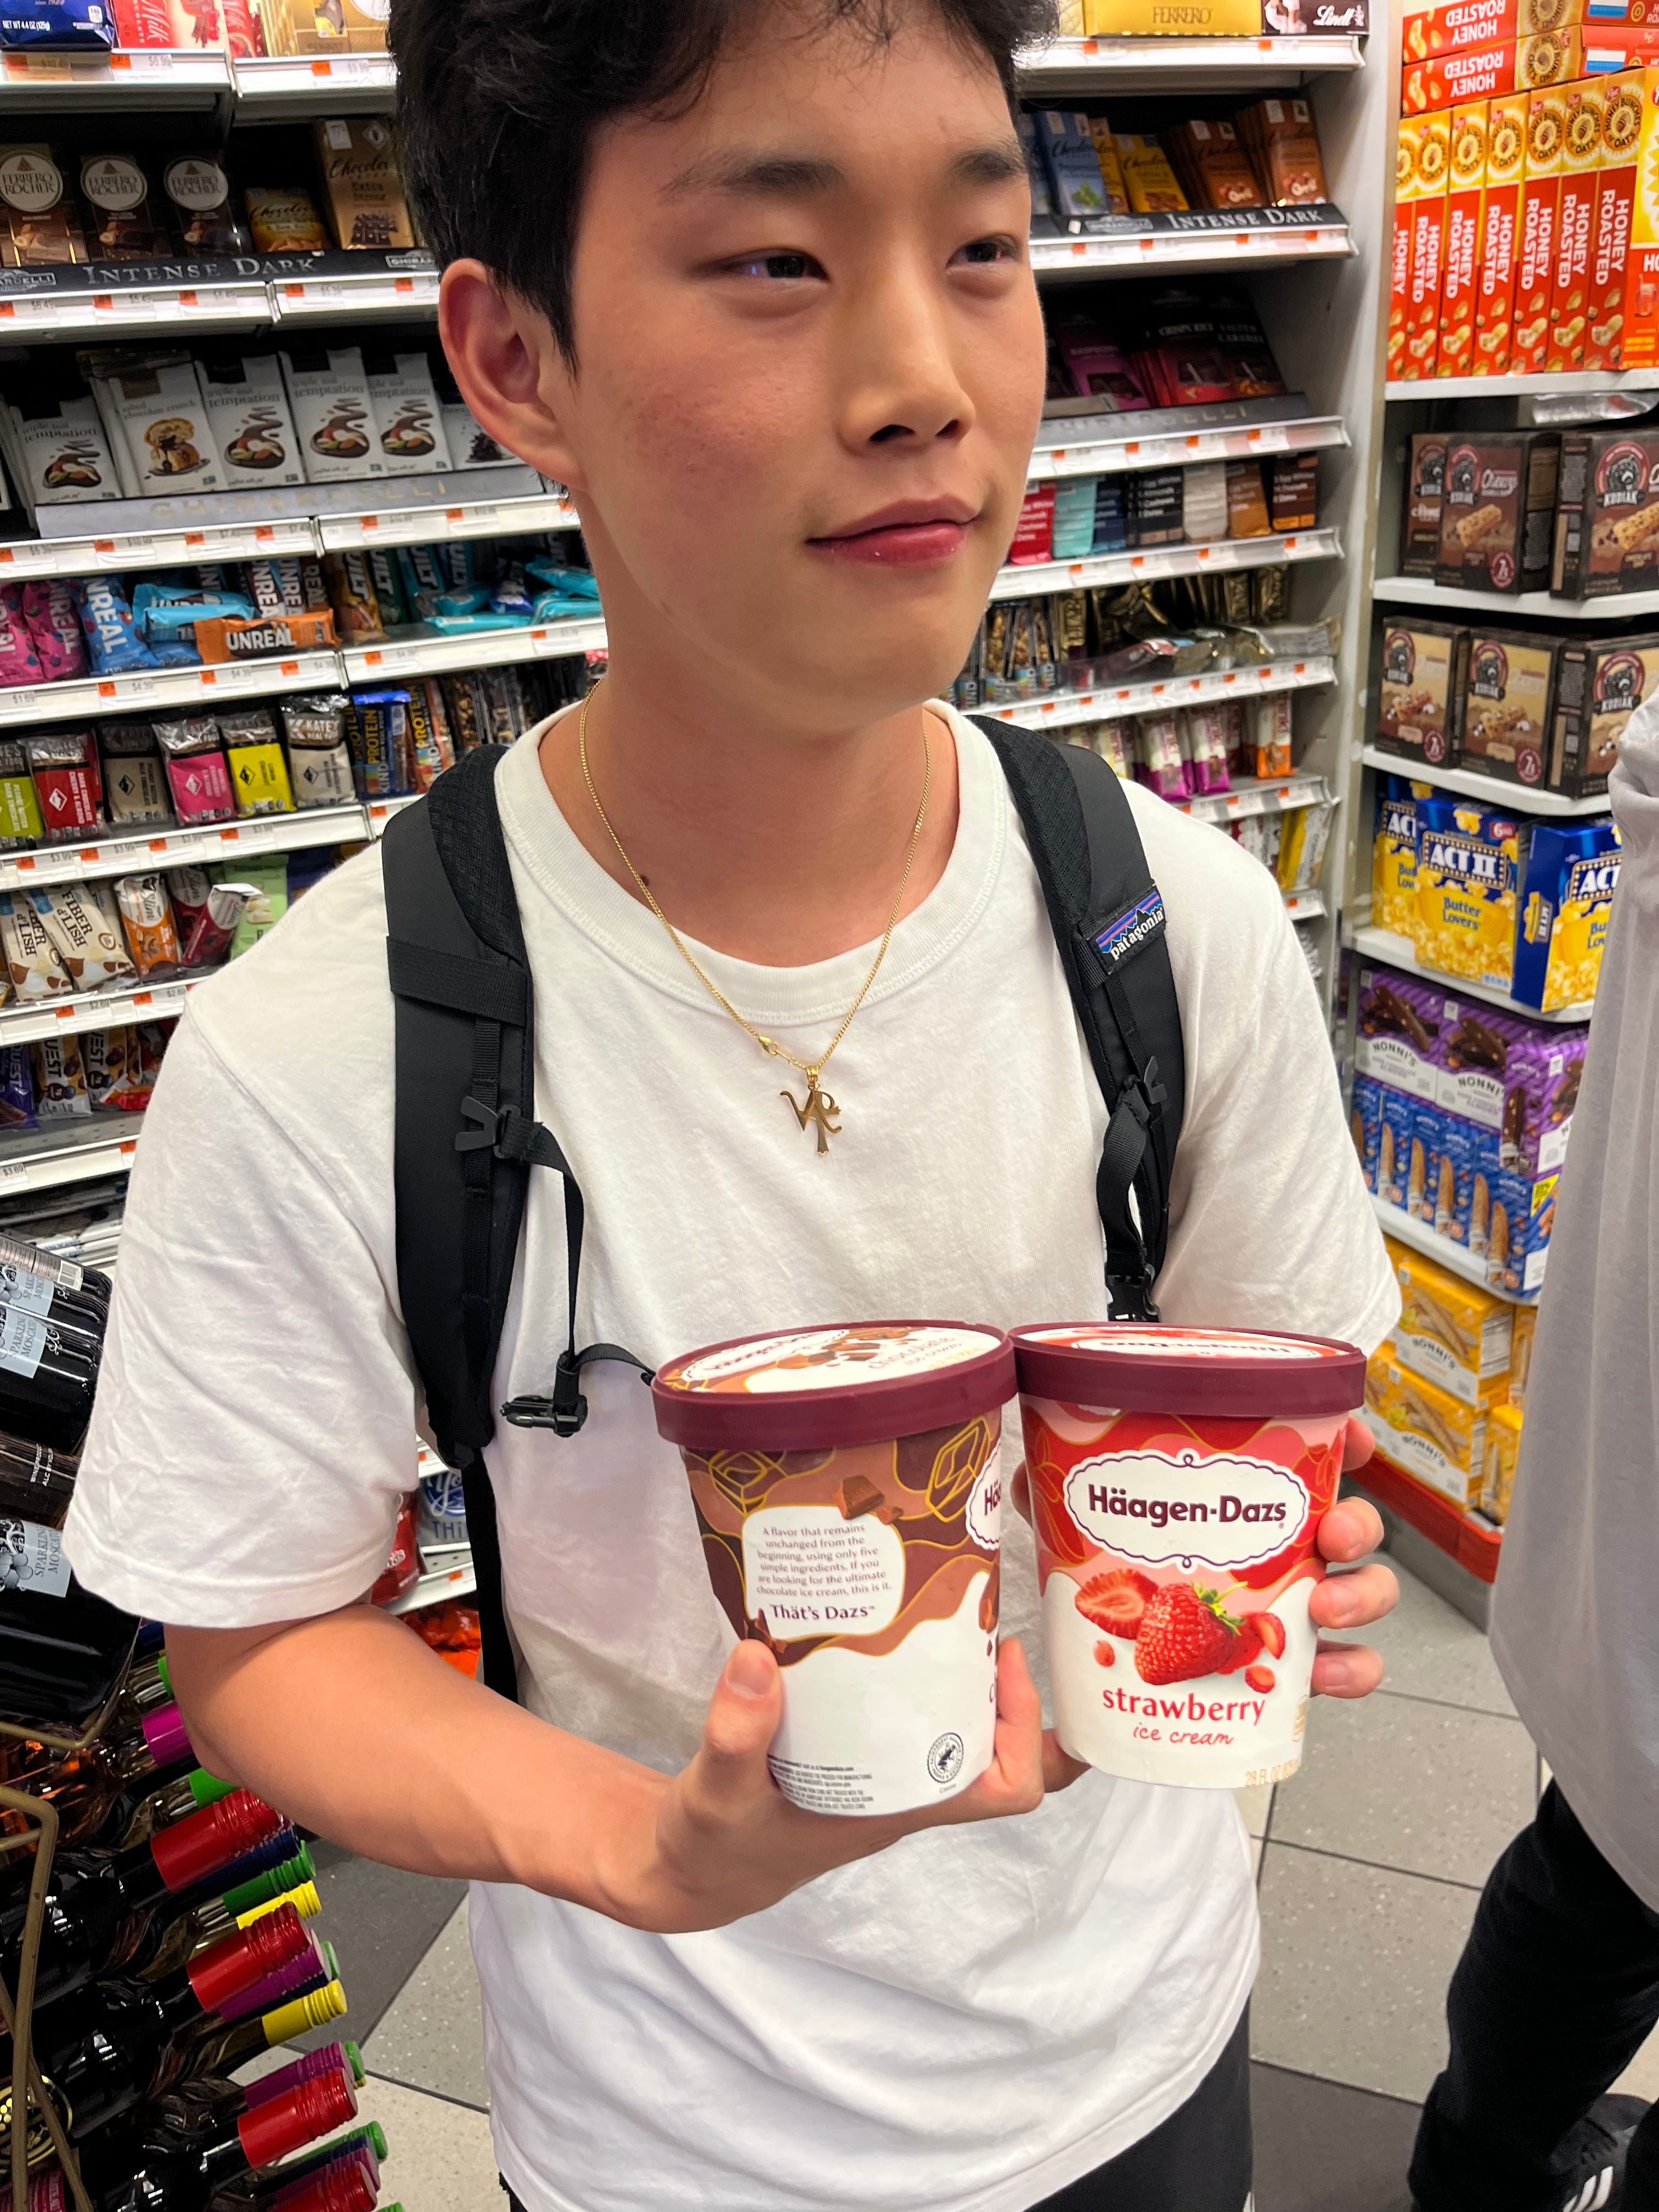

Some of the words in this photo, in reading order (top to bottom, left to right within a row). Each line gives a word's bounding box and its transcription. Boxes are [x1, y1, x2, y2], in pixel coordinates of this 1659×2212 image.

[1153, 5, 1211, 24] FERRERO
[1312, 5, 1356, 27] Lindt
[1451, 19, 1497, 46] HONEY
[1444, 50, 1504, 80] ROASTED
[1449, 71, 1496, 97] HONEY
[1575, 140, 1595, 154] OATS
[1614, 135, 1634, 148] OATS
[4, 181, 55, 195] ROCHER
[1166, 212, 1258, 230] INTENSE
[1263, 208, 1323, 225] DARK
[1595, 188, 1616, 286] ROASTED
[1611, 198, 1629, 273] HONEY
[1446, 210, 1464, 299] ROASTED
[1458, 218, 1476, 287] HONEY
[1482, 205, 1501, 296] ROASTED
[1496, 213, 1513, 284] HONEY
[1521, 198, 1541, 291] ROASTED
[1536, 207, 1553, 278] HONEY
[1558, 194, 1577, 289] ROASTED
[1572, 203, 1590, 275] HONEY
[82, 263, 219, 285] INTENSE
[232, 257, 318, 276] DARK
[1393, 229, 1409, 295] HONEY
[1412, 216, 1429, 304] ROASTED
[1423, 225, 1441, 291] HONEY
[84, 577, 129, 654] NREAL
[225, 623, 297, 653] UNREAL
[366, 709, 385, 765] PROTEIN
[1430, 844, 1470, 872] ACT
[1472, 852, 1497, 878] II
[61, 890, 94, 936] FIBER
[1443, 896, 1482, 917] Butter
[1110, 909, 1164, 961] patagonia
[8, 1315, 26, 1358] SPARKLIN
[21, 1319, 38, 1358] MOSCAT
[1088, 1483, 1286, 1529] Häagen-Dazs
[763, 1527, 770, 1536] A
[771, 1526, 798, 1536] flavor
[801, 1527, 821, 1536] that
[824, 1524, 865, 1535] remains
[766, 1539, 817, 1550] unchanged
[820, 1539, 845, 1549] from
[848, 1538, 865, 1547] the
[758, 1549, 803, 1562] beginning,
[806, 1550, 832, 1562] using
[836, 1549, 857, 1560] only
[860, 1547, 878, 1557] five
[760, 1563, 788, 1574] simple
[850, 1562, 858, 1570] If
[861, 1560, 879, 1571] you
[757, 1585, 797, 1596] chocolate
[800, 1587, 814, 1596] ice
[816, 1587, 849, 1598] cream,
[851, 1585, 870, 1594] this
[872, 1584, 879, 1593] is
[882, 1582, 891, 1591] it.
[773, 1575, 807, 1586] looking
[809, 1575, 823, 1584] for
[826, 1574, 843, 1583] the
[845, 1571, 886, 1582] ultimate
[769, 1604, 820, 1620] Thät's
[1102, 1686, 1265, 1726] strawberry
[1133, 1722, 1161, 1741] ice
[1170, 1730, 1234, 1745] cream
